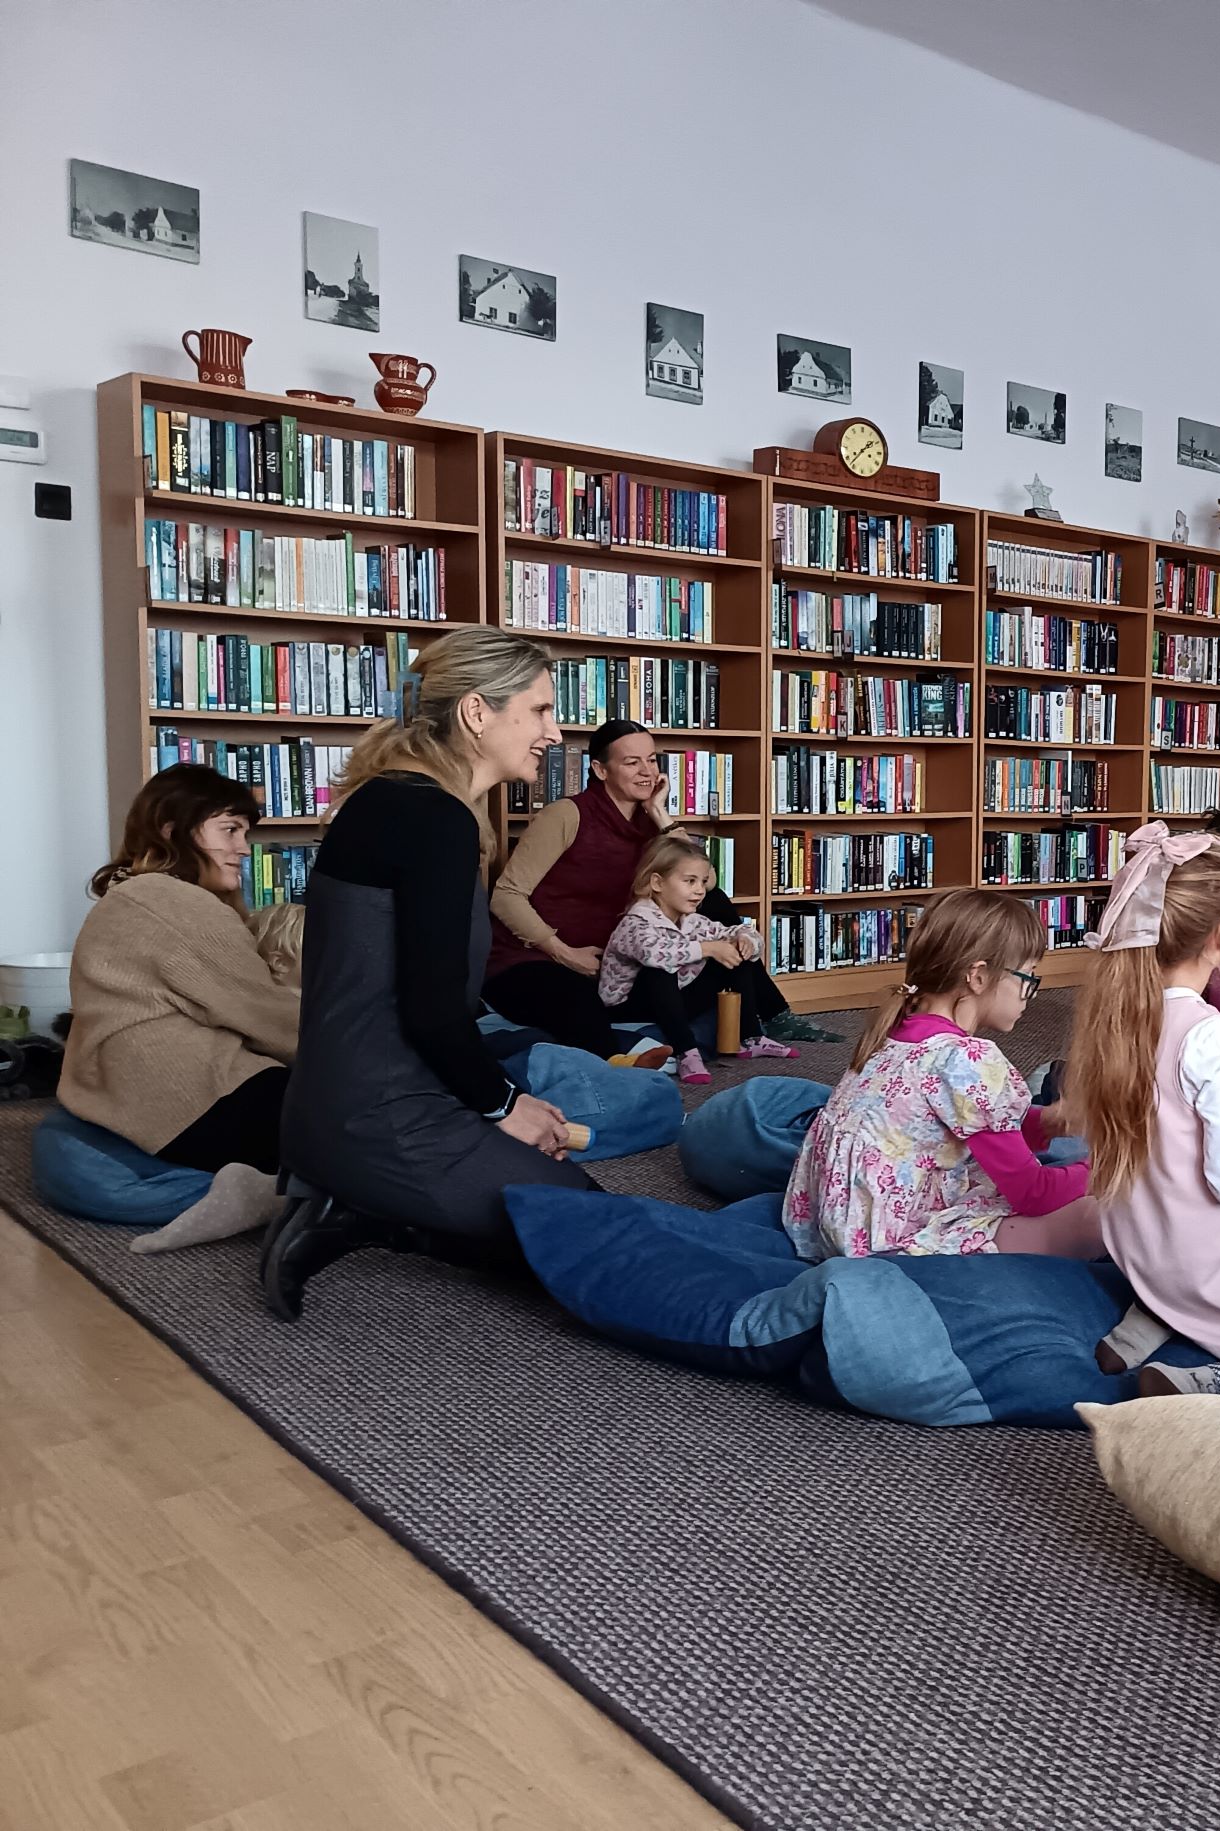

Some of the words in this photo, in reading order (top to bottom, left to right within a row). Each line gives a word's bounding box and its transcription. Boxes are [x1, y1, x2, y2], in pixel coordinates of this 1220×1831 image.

[1155, 589, 1163, 599] R
[645, 669, 653, 694] SOHA
[922, 690, 943, 701] KING
[840, 720, 846, 729] K
[1163, 735, 1170, 746] S
[238, 760, 248, 783] SAPHO
[252, 760, 262, 783] SAPHO
[304, 768, 314, 795] BROWN
[1079, 864, 1085, 873] P
